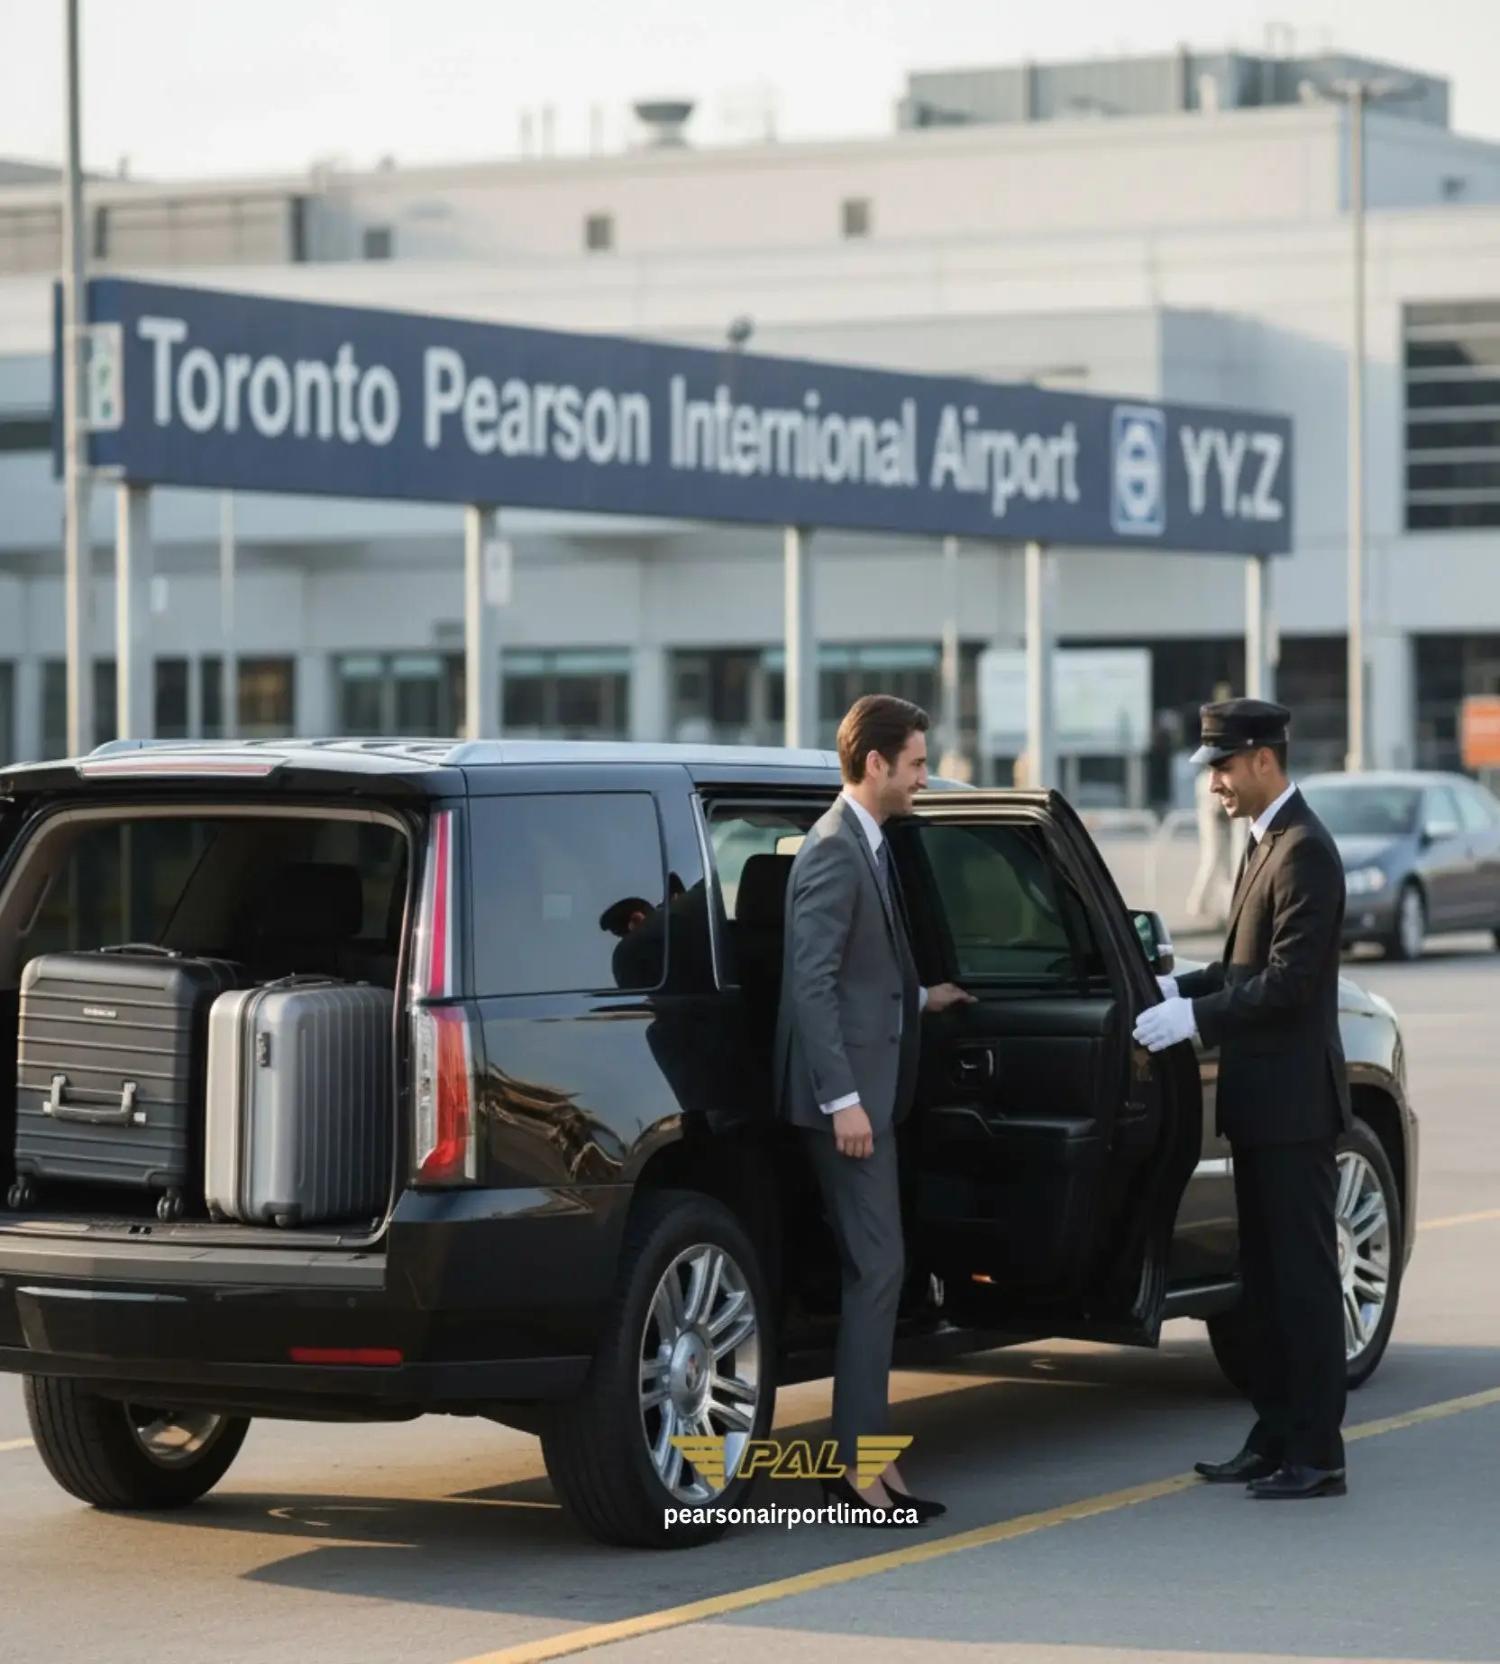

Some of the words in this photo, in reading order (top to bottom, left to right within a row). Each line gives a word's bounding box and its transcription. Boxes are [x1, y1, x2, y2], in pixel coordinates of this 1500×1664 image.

[137, 315, 399, 446] Toronto
[423, 346, 650, 466] Pearson
[930, 403, 1079, 517] Airport
